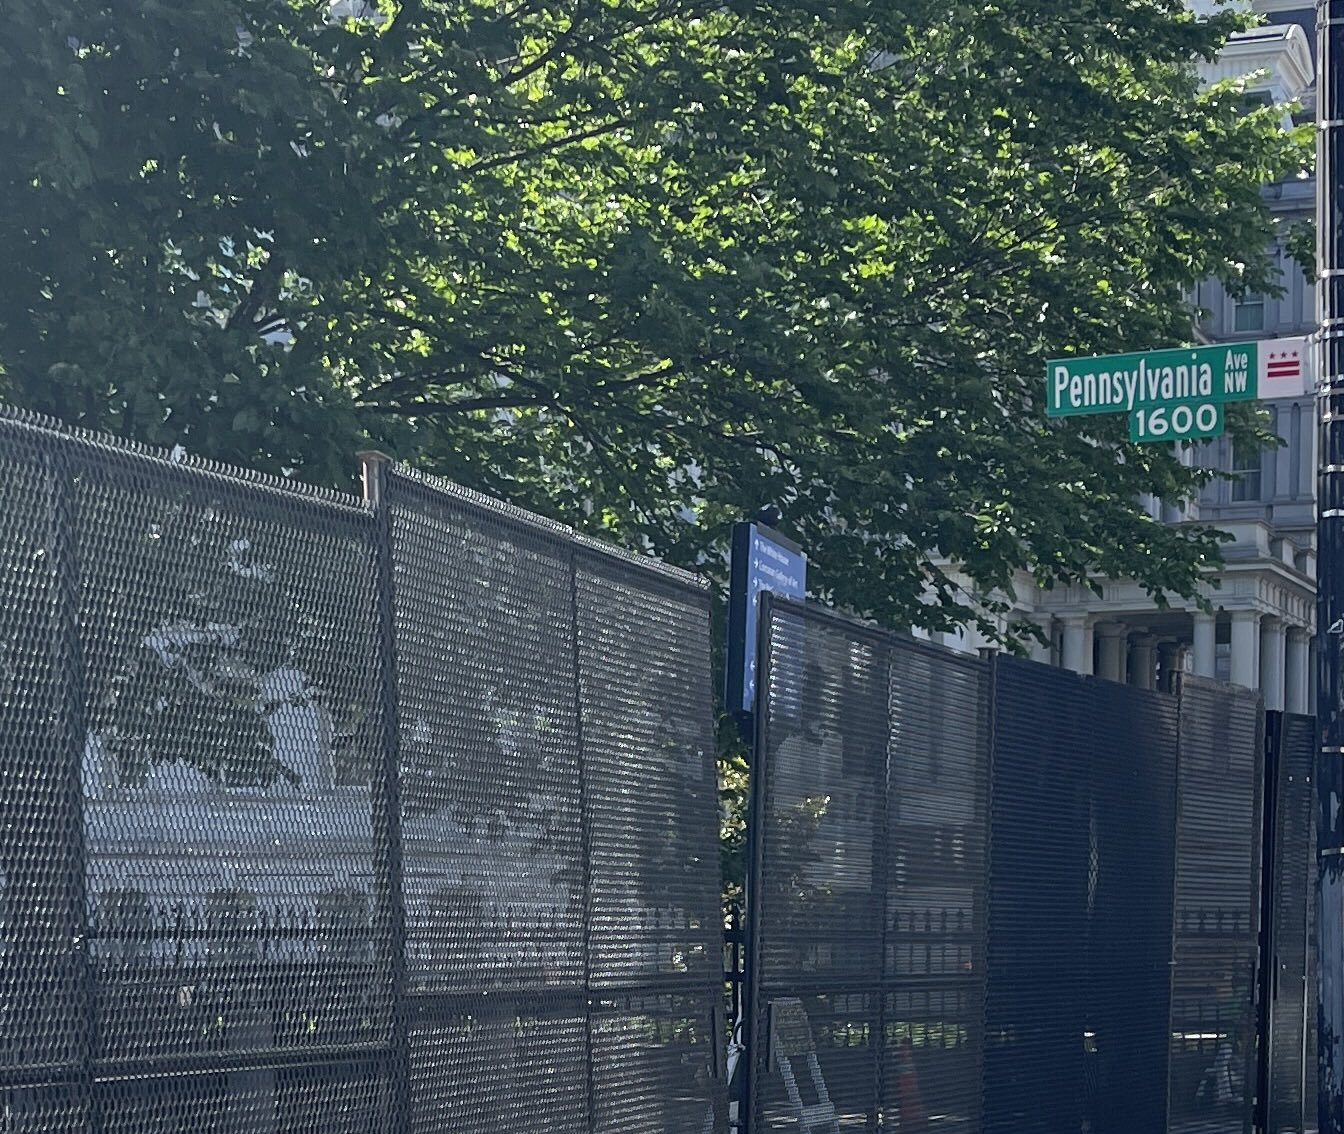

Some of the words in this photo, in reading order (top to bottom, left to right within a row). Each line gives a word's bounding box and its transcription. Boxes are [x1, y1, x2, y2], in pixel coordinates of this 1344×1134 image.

[1054, 352, 1212, 411] Pennsylvania
[1224, 349, 1249, 371] Ave
[1224, 370, 1248, 394] NW
[1135, 403, 1218, 437] 1600
